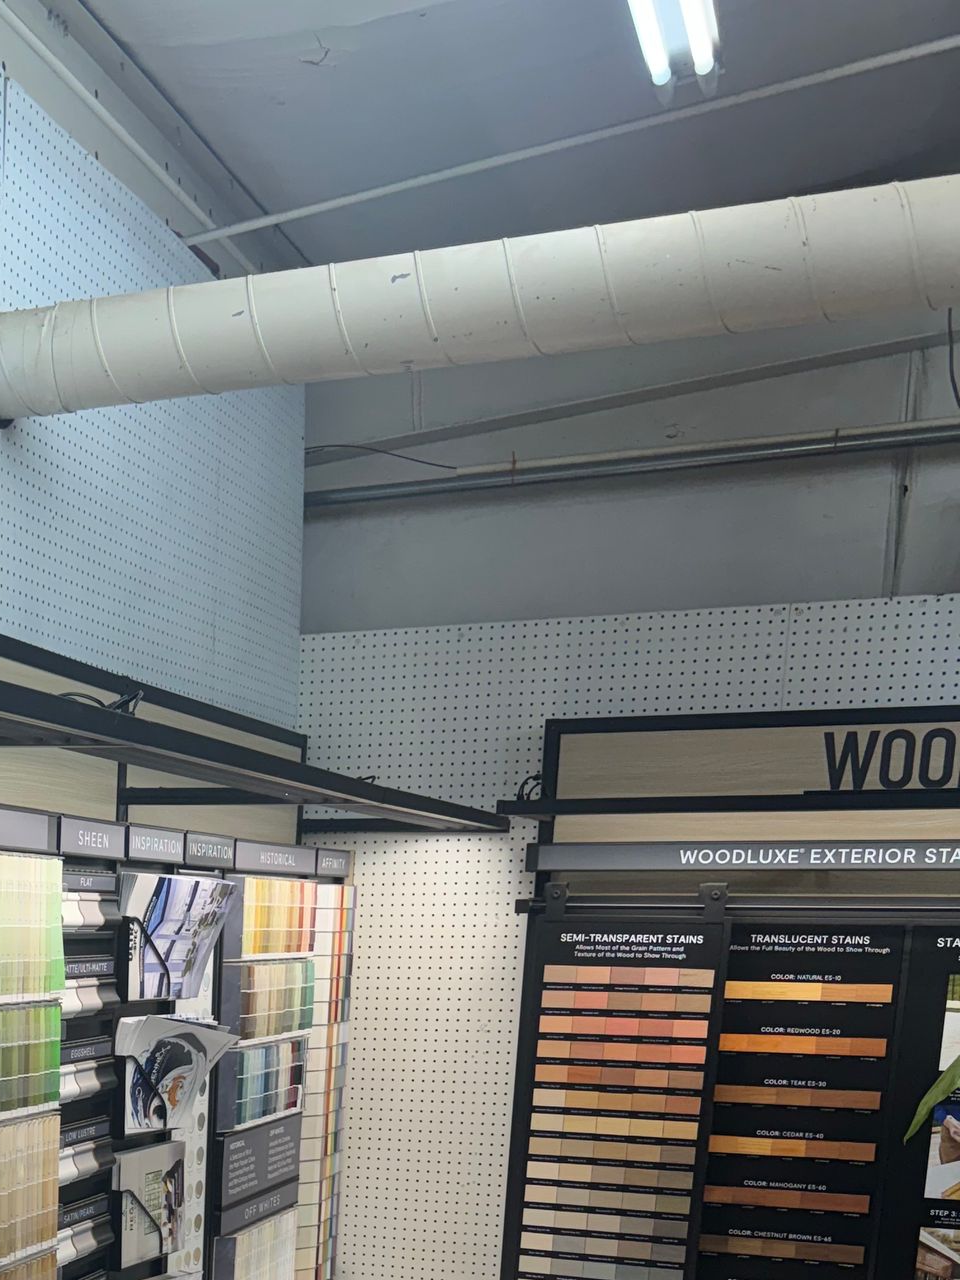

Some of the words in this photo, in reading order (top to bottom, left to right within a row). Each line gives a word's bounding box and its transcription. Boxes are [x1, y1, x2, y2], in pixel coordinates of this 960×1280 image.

[824, 728, 960, 790] WOO
[78, 830, 109, 848] SHEEN
[132, 835, 181, 854] INSPIRATION
[189, 841, 233, 860] INSPIRATION
[809, 847, 916, 864] EXTERIOR
[260, 852, 295, 866] HISTORICAL
[321, 857, 345, 870] AFFINITY
[79, 877, 93, 887] FLAT
[560, 932, 664, 944] SEMI-TRANSPARENT
[665, 934, 704, 944] STAINS
[750, 934, 828, 944] TRANSLUCENT
[831, 935, 871, 945] STAINS
[774, 945, 795, 953] Beauty
[864, 947, 890, 955] Through
[70, 1047, 96, 1059] EGGSHELL
[65, 1131, 77, 1142] LOW
[77, 1126, 96, 1139] LUSTRE
[769, 1181, 806, 1189] MAHOGANY
[244, 1204, 257, 1219] OFF
[258, 1194, 280, 1213] WHITES
[929, 1209, 949, 1217] STEP
[754, 1231, 787, 1239] CHESTNUT
[788, 1233, 812, 1241] BROWN
